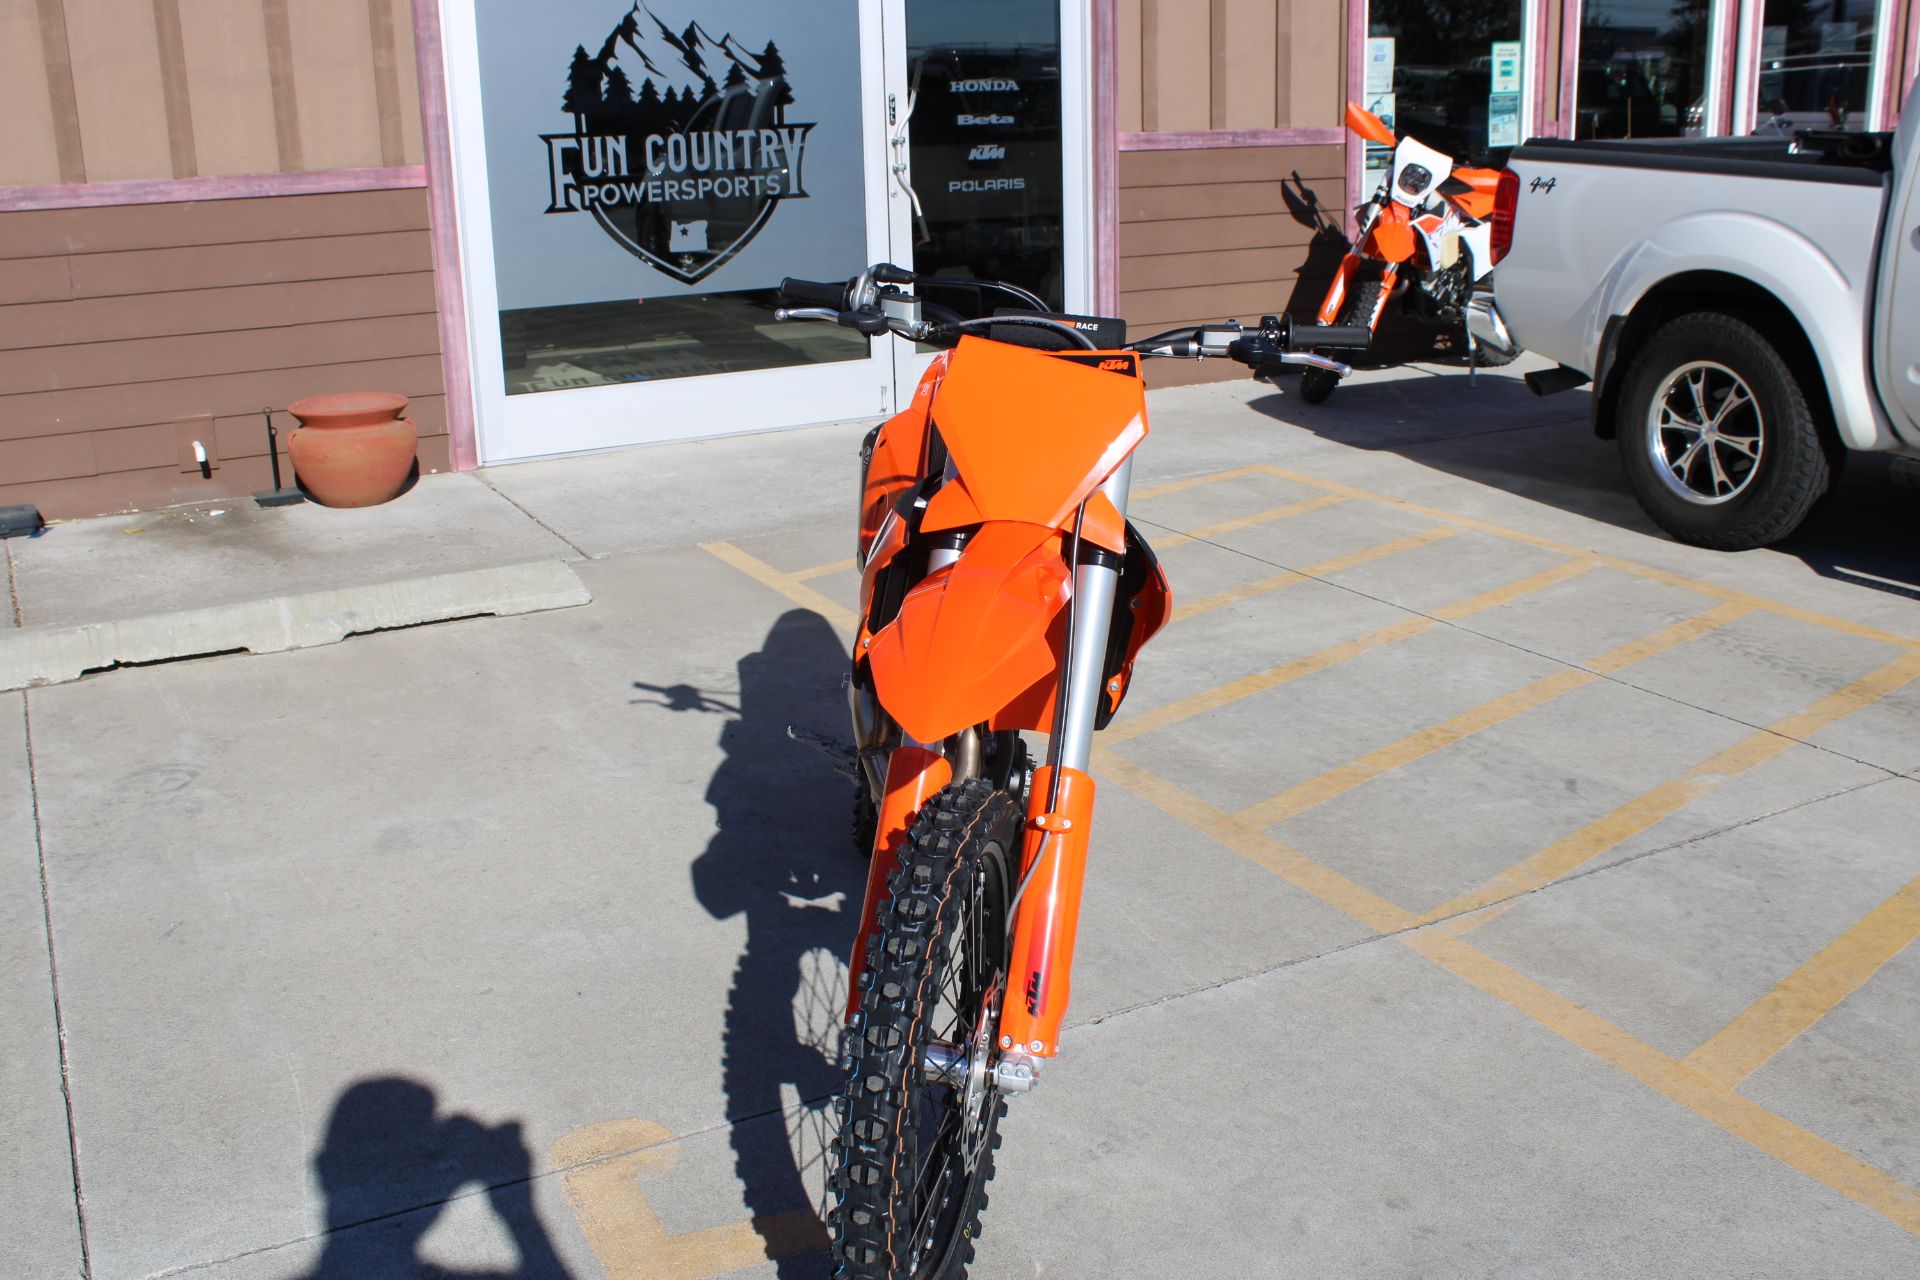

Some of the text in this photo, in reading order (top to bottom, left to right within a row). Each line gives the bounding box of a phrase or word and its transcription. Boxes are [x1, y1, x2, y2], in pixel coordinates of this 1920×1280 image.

[950, 80, 1020, 92] HONDA
[957, 114, 1015, 125] Beta
[968, 145, 1005, 160] KTM
[549, 127, 809, 209] FUN COUNTRY
[583, 174, 781, 207] POWERSPORTS
[949, 178, 1025, 192] POLARIS
[1529, 176, 1557, 194] 4x4
[1075, 322, 1098, 331] RACE
[1099, 360, 1129, 370] KTM
[1026, 971, 1042, 1017] KTM
